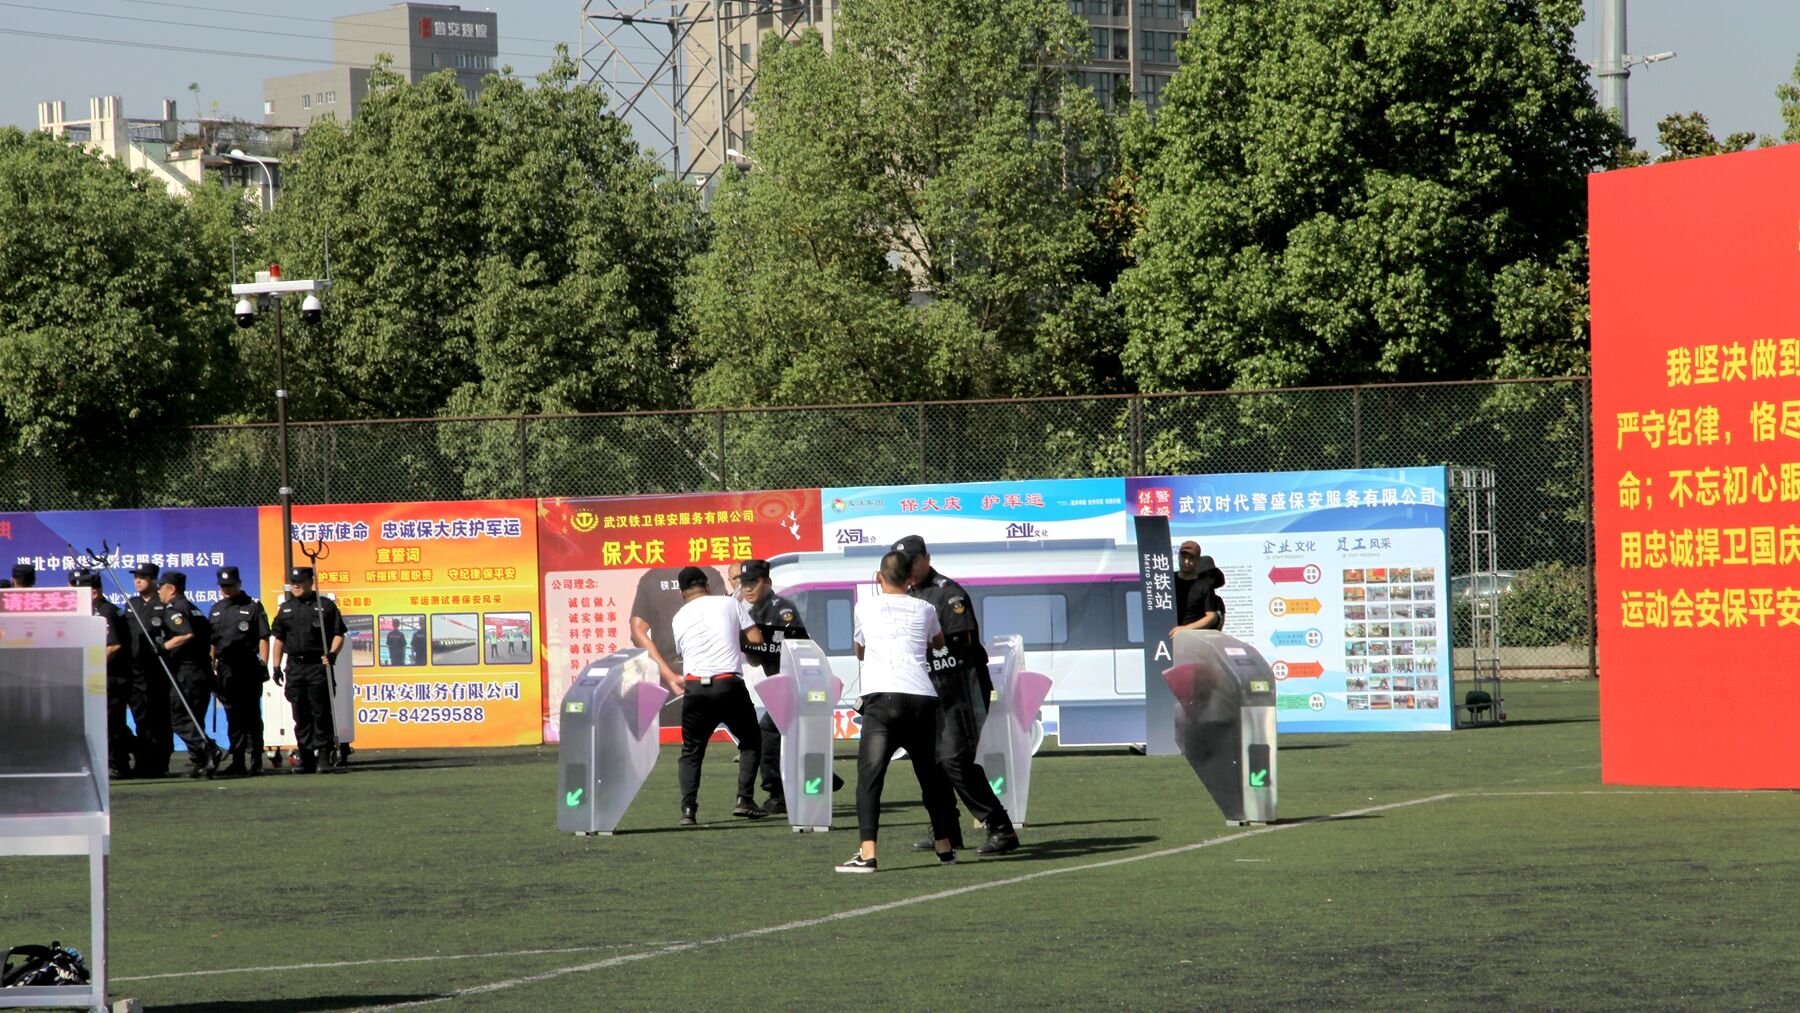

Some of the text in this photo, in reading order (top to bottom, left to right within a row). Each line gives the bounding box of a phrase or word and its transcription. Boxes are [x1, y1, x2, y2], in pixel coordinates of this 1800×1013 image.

[1667, 338, 1800, 387] 我坚决做到
[899, 497, 961, 512] 保大庆
[981, 493, 1045, 510] 护军运
[1179, 487, 1436, 513] 武汉时代警盛保安服务有限公司
[383, 519, 520, 539] 忠诚保大庆护军运
[604, 510, 754, 529] 武汉铁卫保安服务有限公司
[377, 547, 420, 563] 宣誓词
[602, 536, 752, 566] 保大庆 护军运
[1143, 553, 1151, 579] Metro
[1152, 553, 1172, 610] 地铁站
[568, 597, 616, 608] 诚信做人
[1621, 587, 1800, 629] 运动会安保平安
[569, 611, 616, 623] 诚实做事
[569, 627, 617, 639] 科学管理
[1154, 641, 1172, 661] A
[358, 707, 484, 724] 027-84259588
